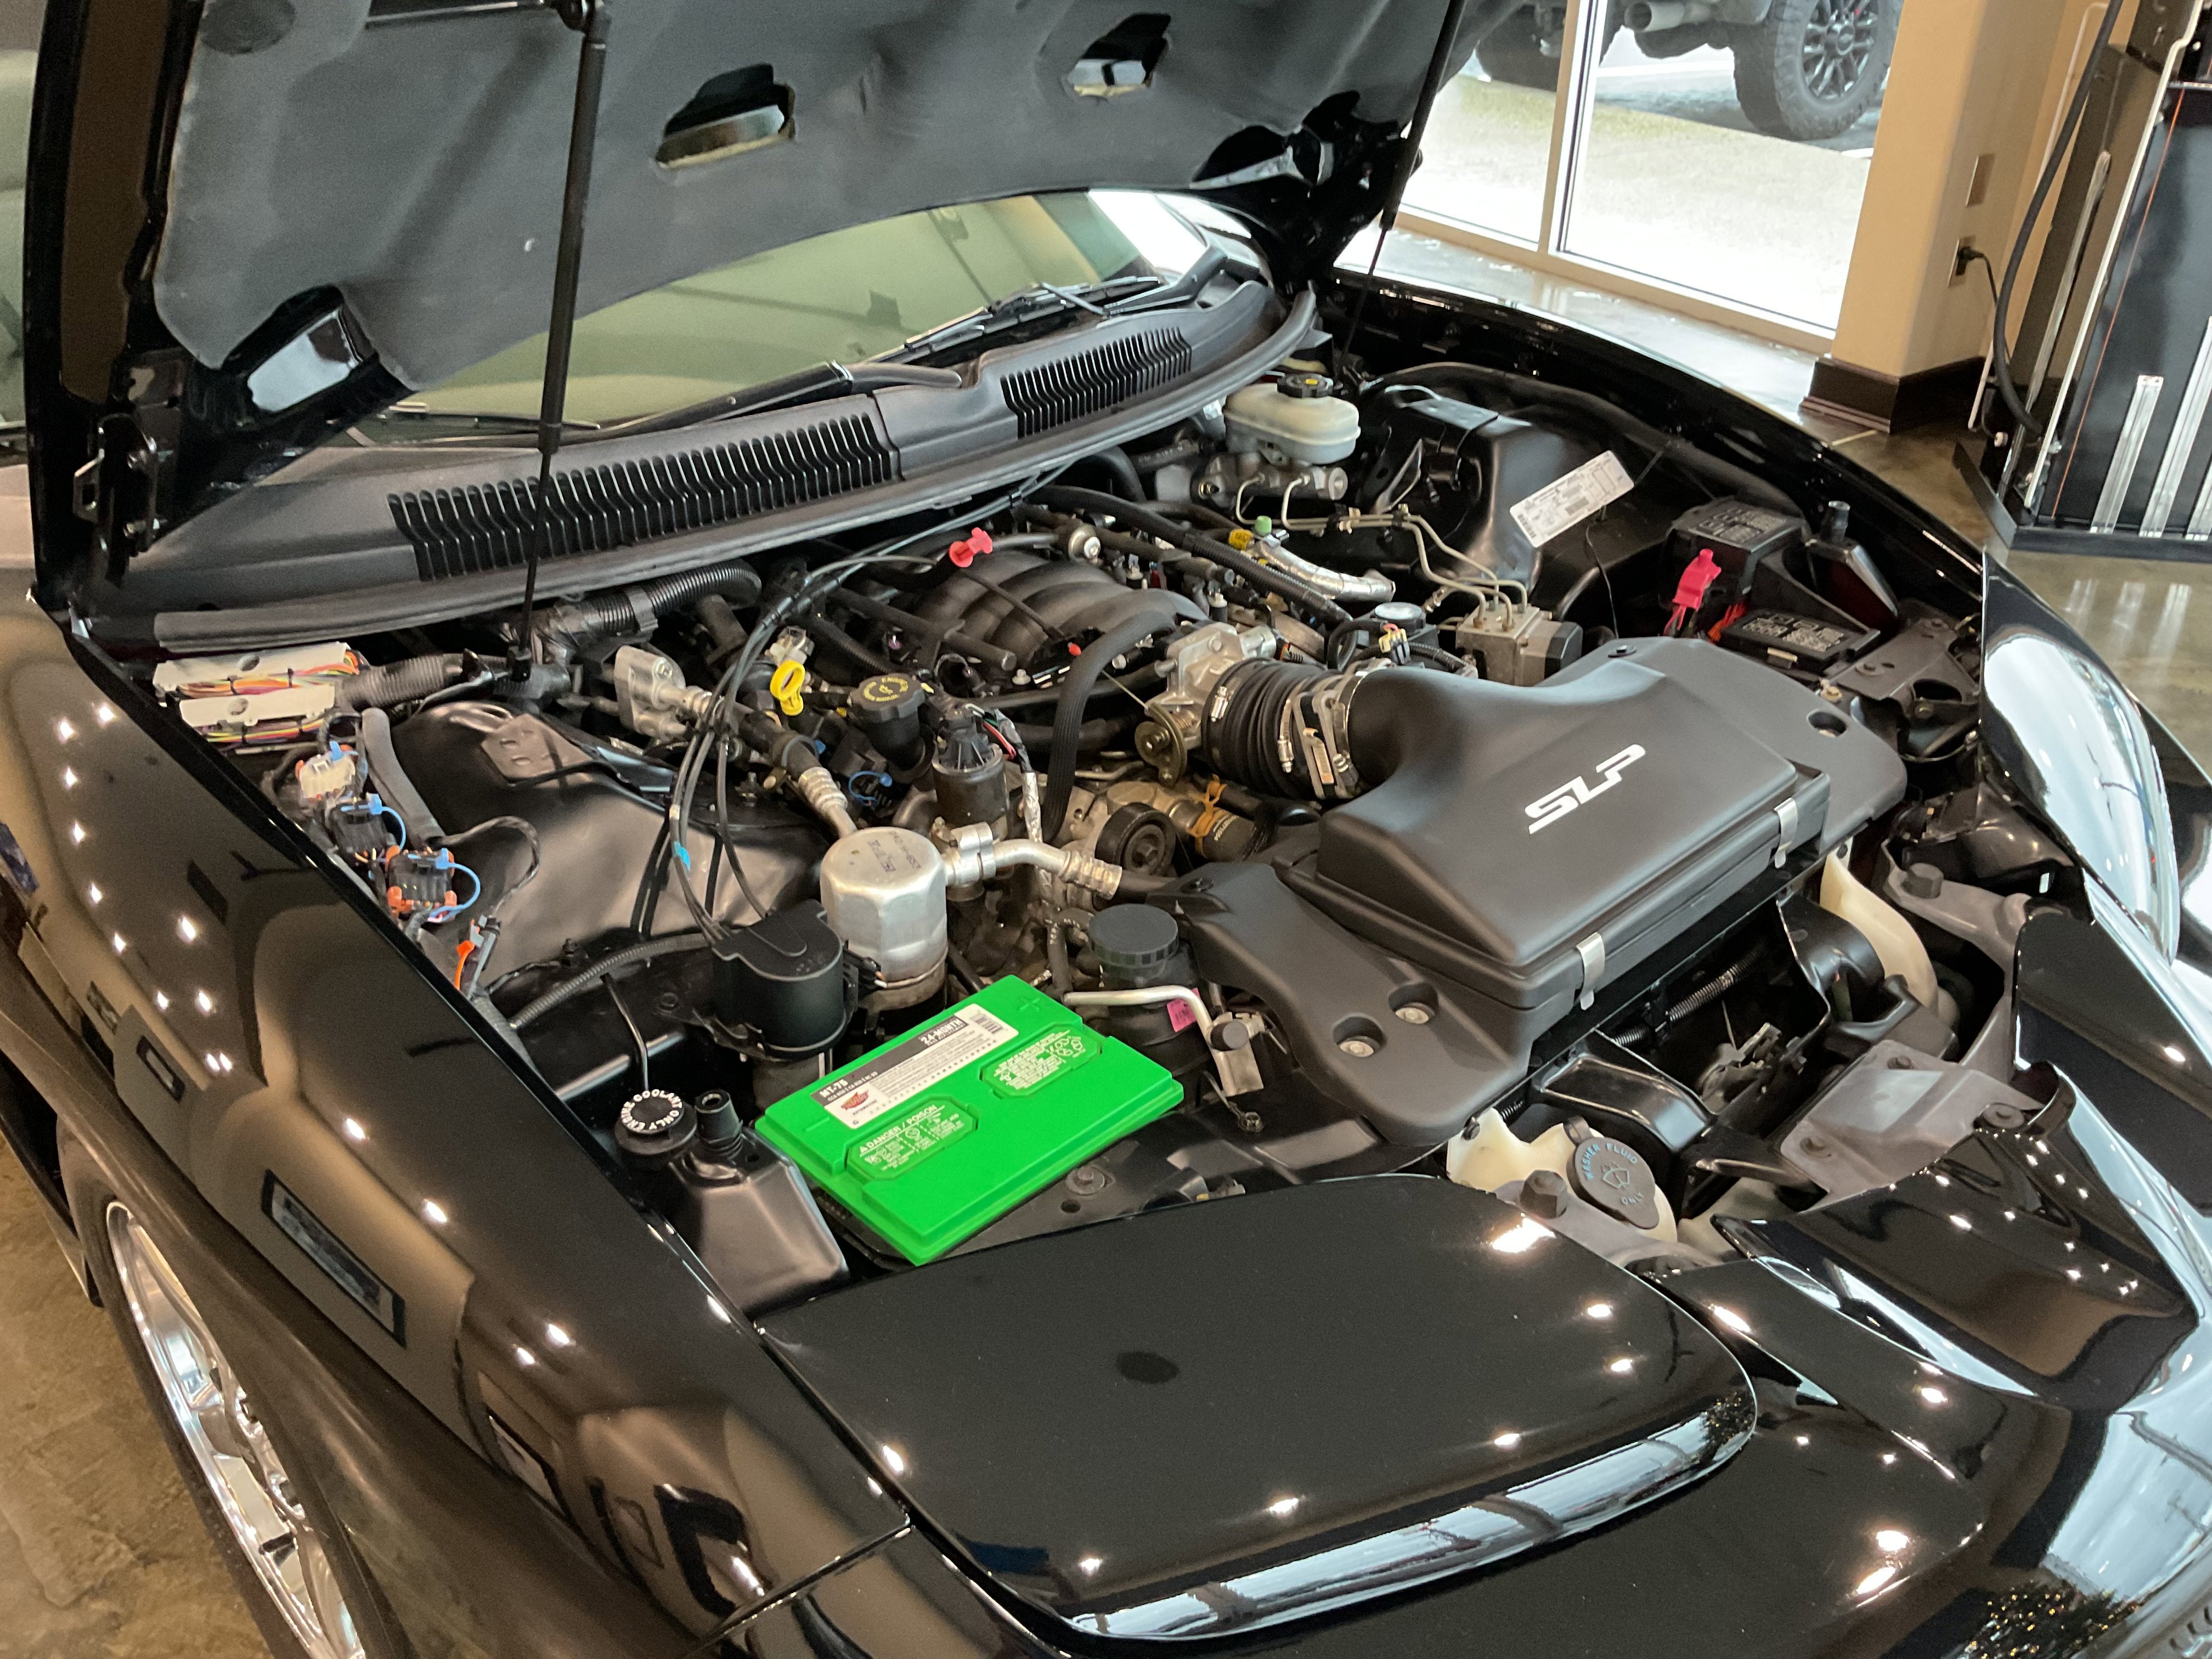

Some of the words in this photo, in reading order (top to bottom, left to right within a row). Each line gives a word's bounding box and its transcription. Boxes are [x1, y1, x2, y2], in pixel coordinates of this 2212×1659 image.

[1525, 744, 1645, 834] SLP
[921, 1018, 963, 1045] 24-MONTH
[633, 1088, 682, 1109] COOLANT
[819, 1079, 848, 1098] MT-75
[648, 1110, 679, 1130] ONLY
[866, 1126, 901, 1148] DANGER
[906, 1104, 938, 1125] POISON
[1582, 1144, 1600, 1181] WASHER
[1606, 1143, 1637, 1164] FLUID
[1621, 1192, 1643, 1205] ONLY
